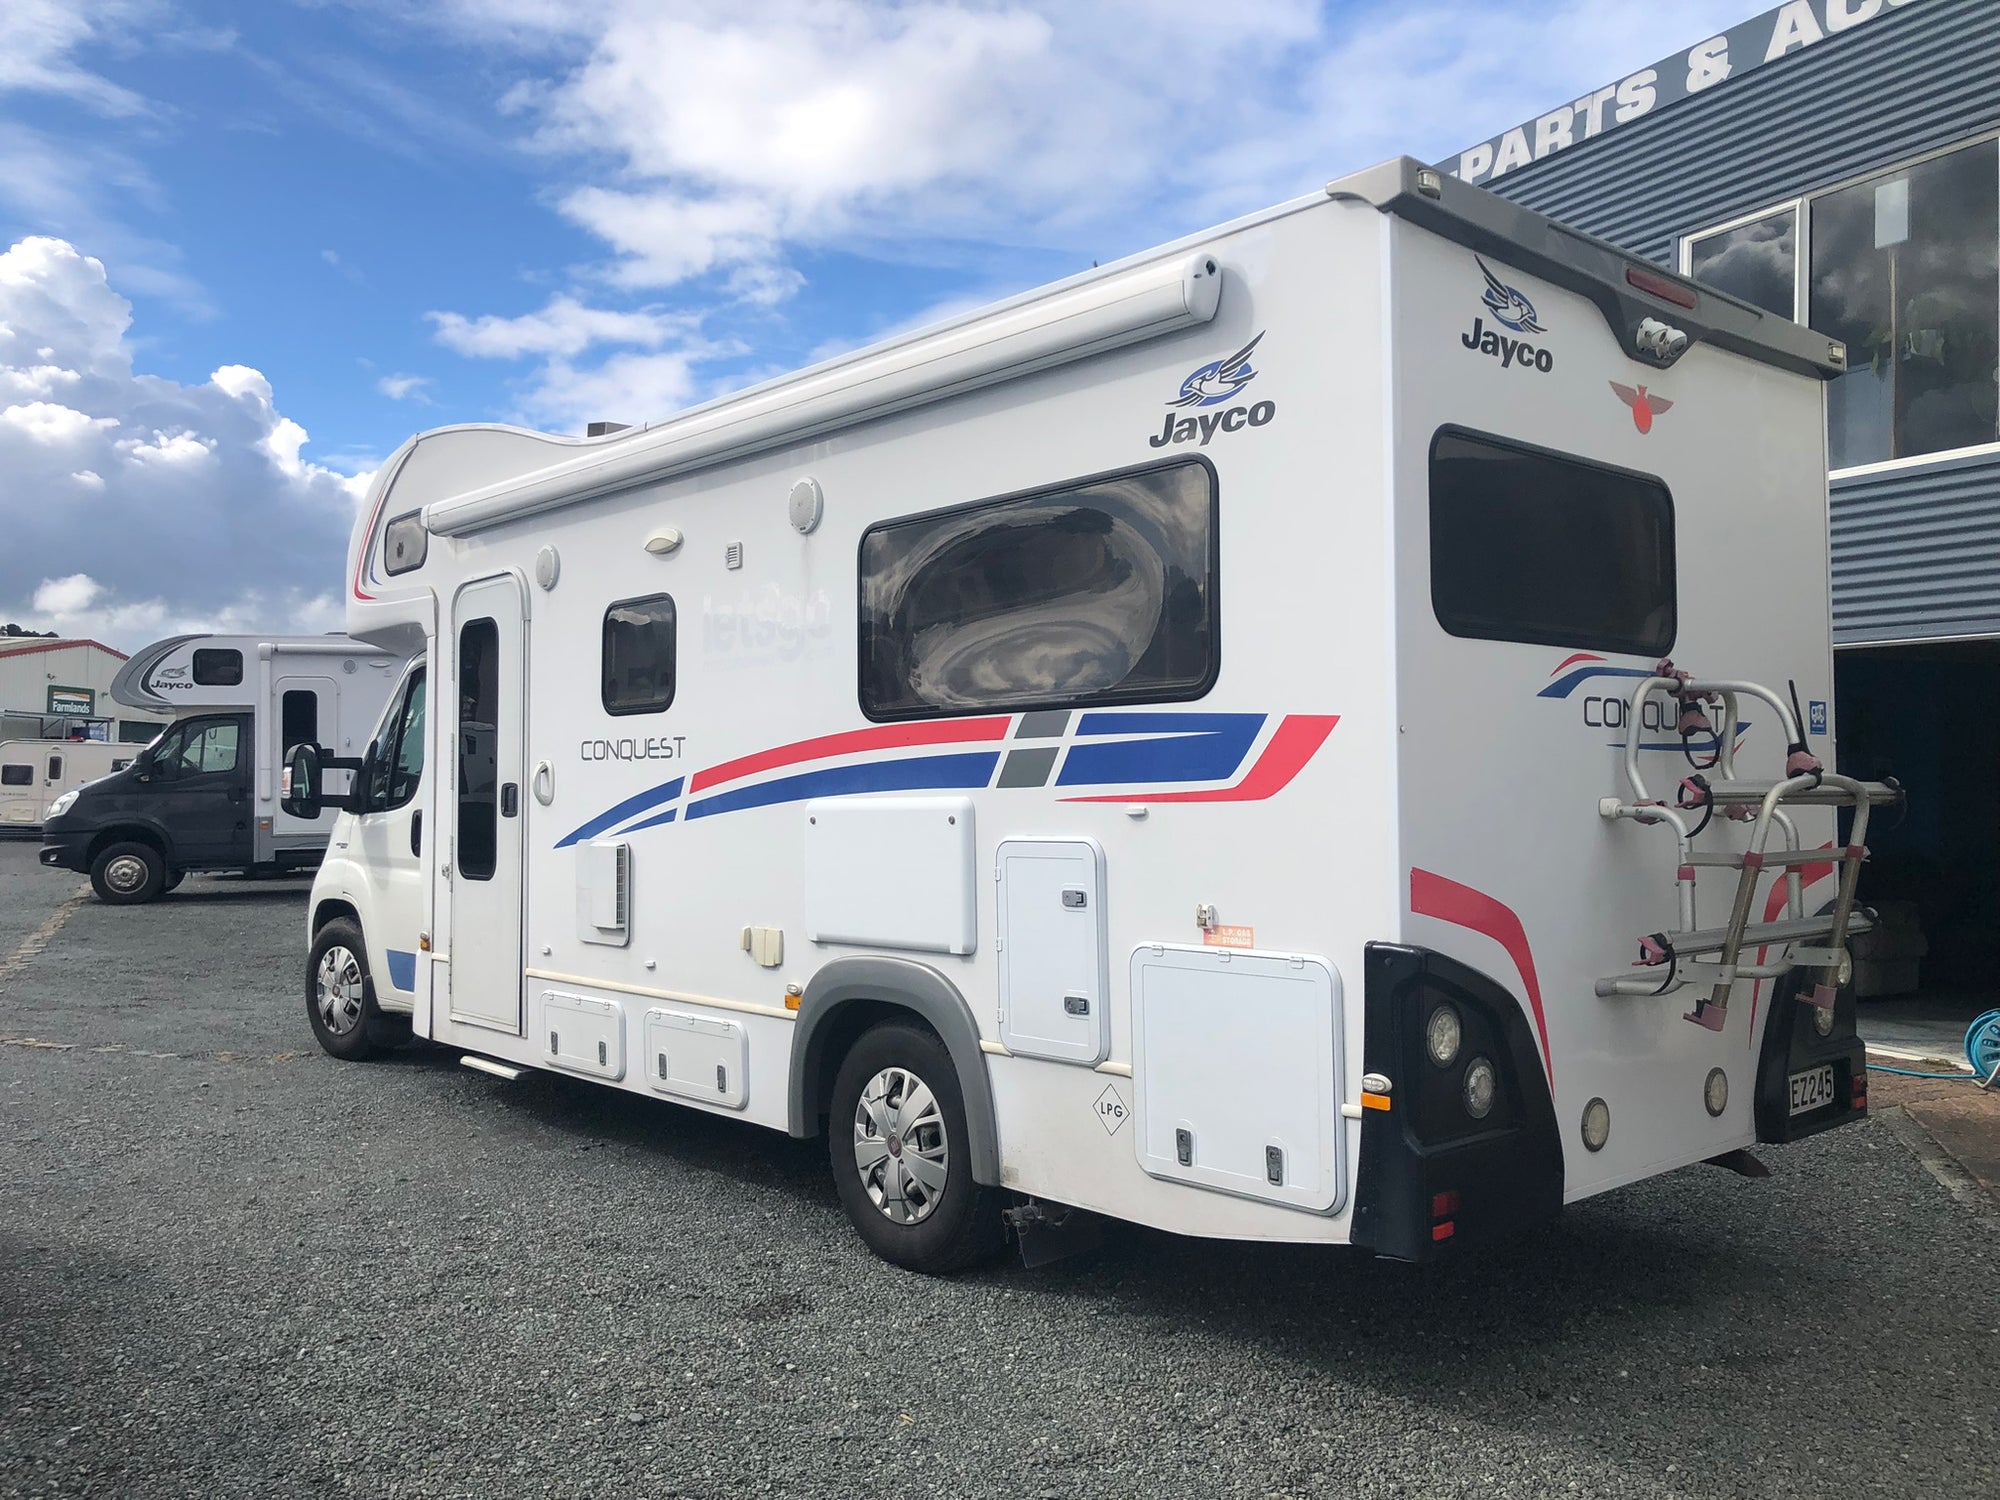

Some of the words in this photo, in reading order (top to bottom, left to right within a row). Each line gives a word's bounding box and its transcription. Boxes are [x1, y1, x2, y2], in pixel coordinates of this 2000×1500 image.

[1686, 36, 1732, 92] &
[1462, 317, 1553, 373] Jayco
[1149, 400, 1276, 448] Jayco
[151, 680, 193, 690] Jayco
[53, 701, 90, 714] Farmlands
[581, 736, 686, 762] CONQUEST
[1100, 1102, 1123, 1118] LPG
